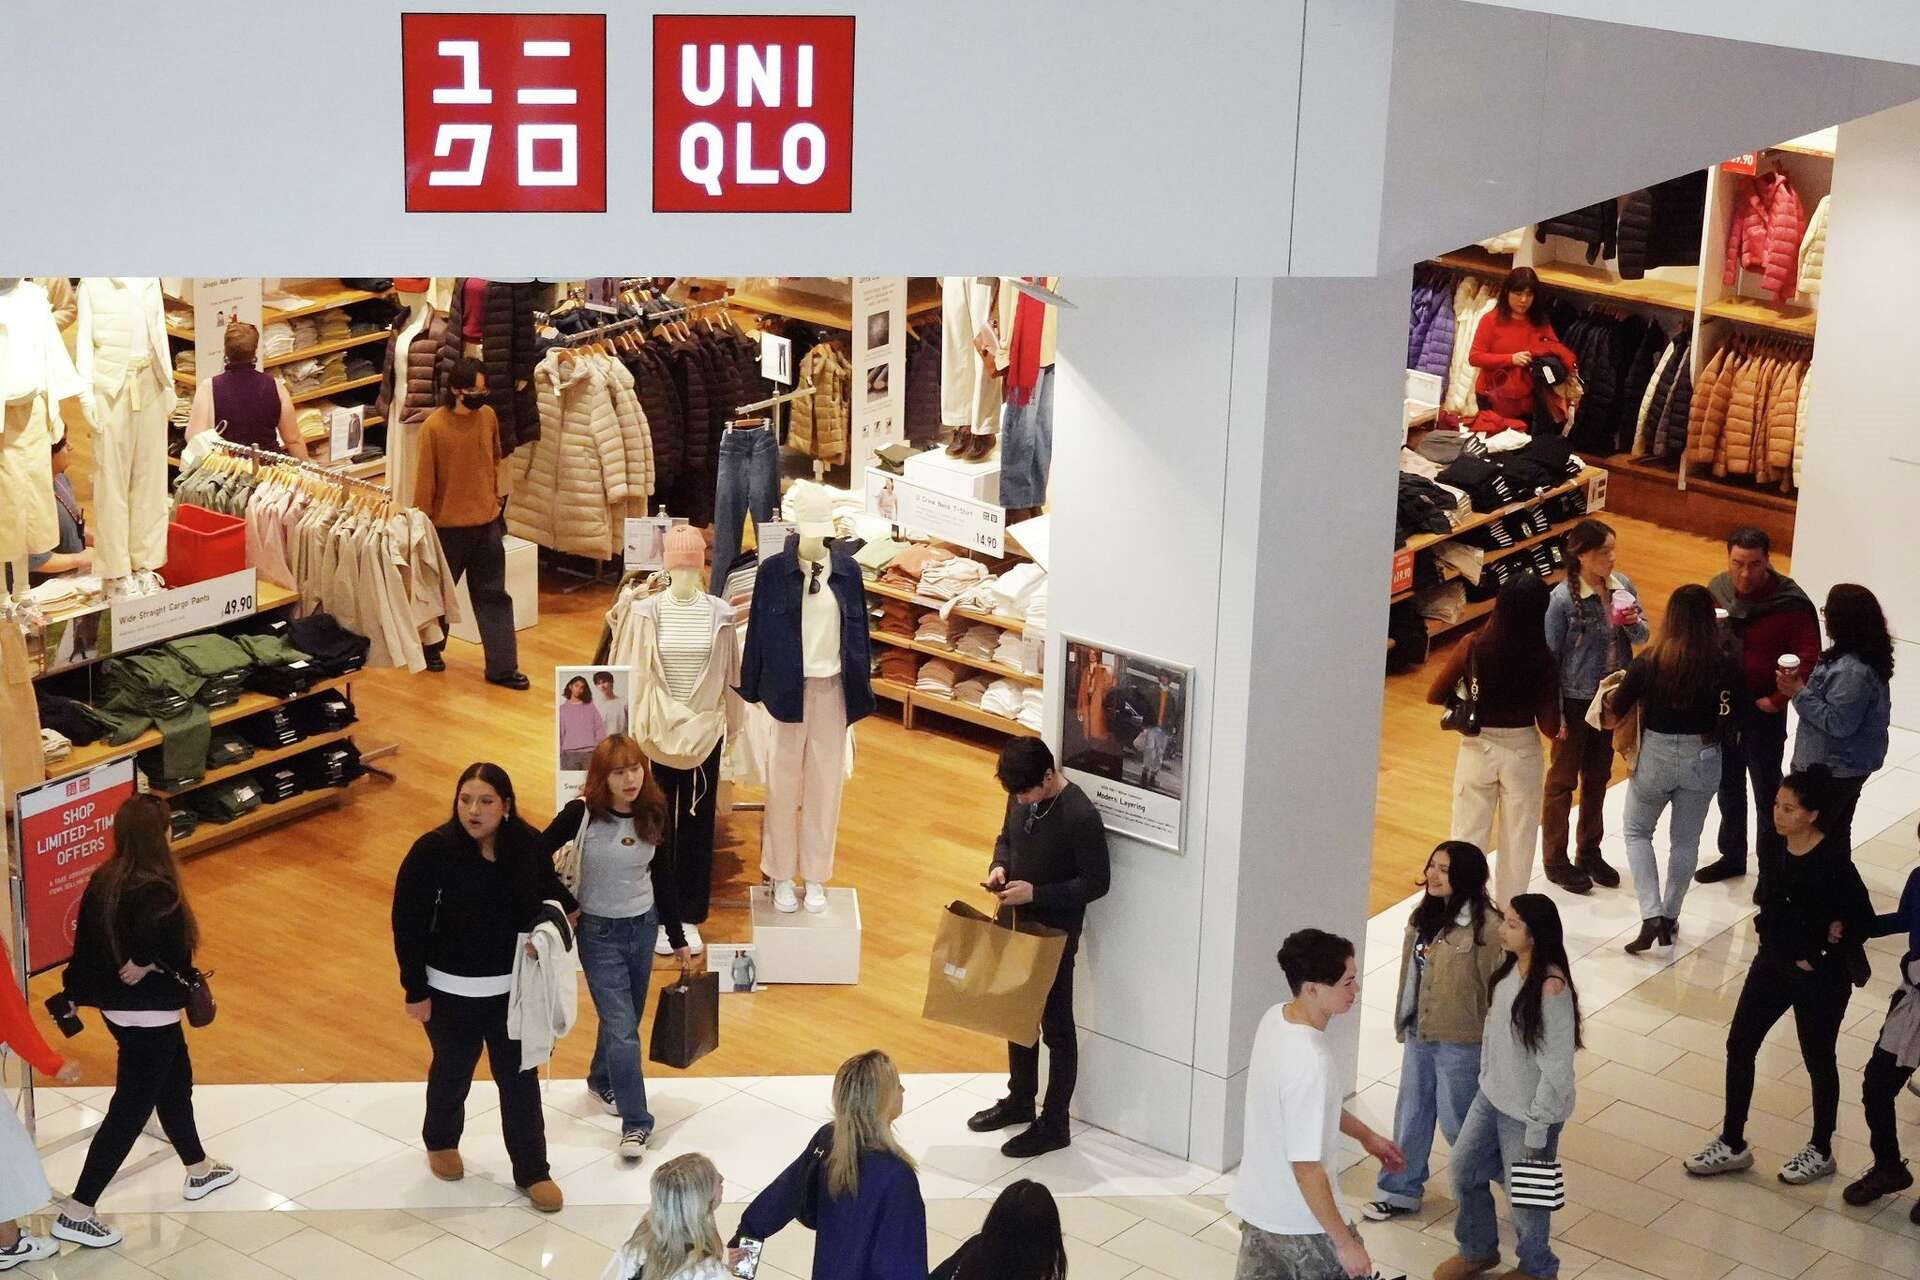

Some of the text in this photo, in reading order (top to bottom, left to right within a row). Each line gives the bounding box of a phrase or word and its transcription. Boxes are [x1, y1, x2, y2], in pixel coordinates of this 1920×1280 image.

[432, 40, 577, 104] ユニ
[681, 44, 814, 107] UNI
[428, 124, 577, 186] クロ
[679, 121, 826, 196] QLO
[975, 532, 998, 549] 14.90
[119, 593, 210, 625] Wide Straight Cargo Pants
[63, 802, 96, 826] SHOP
[1096, 790, 1117, 804] Modern
[1119, 798, 1146, 814] Layering
[37, 814, 115, 855] LIMITED-TIM
[57, 836, 105, 866] OFFERS
